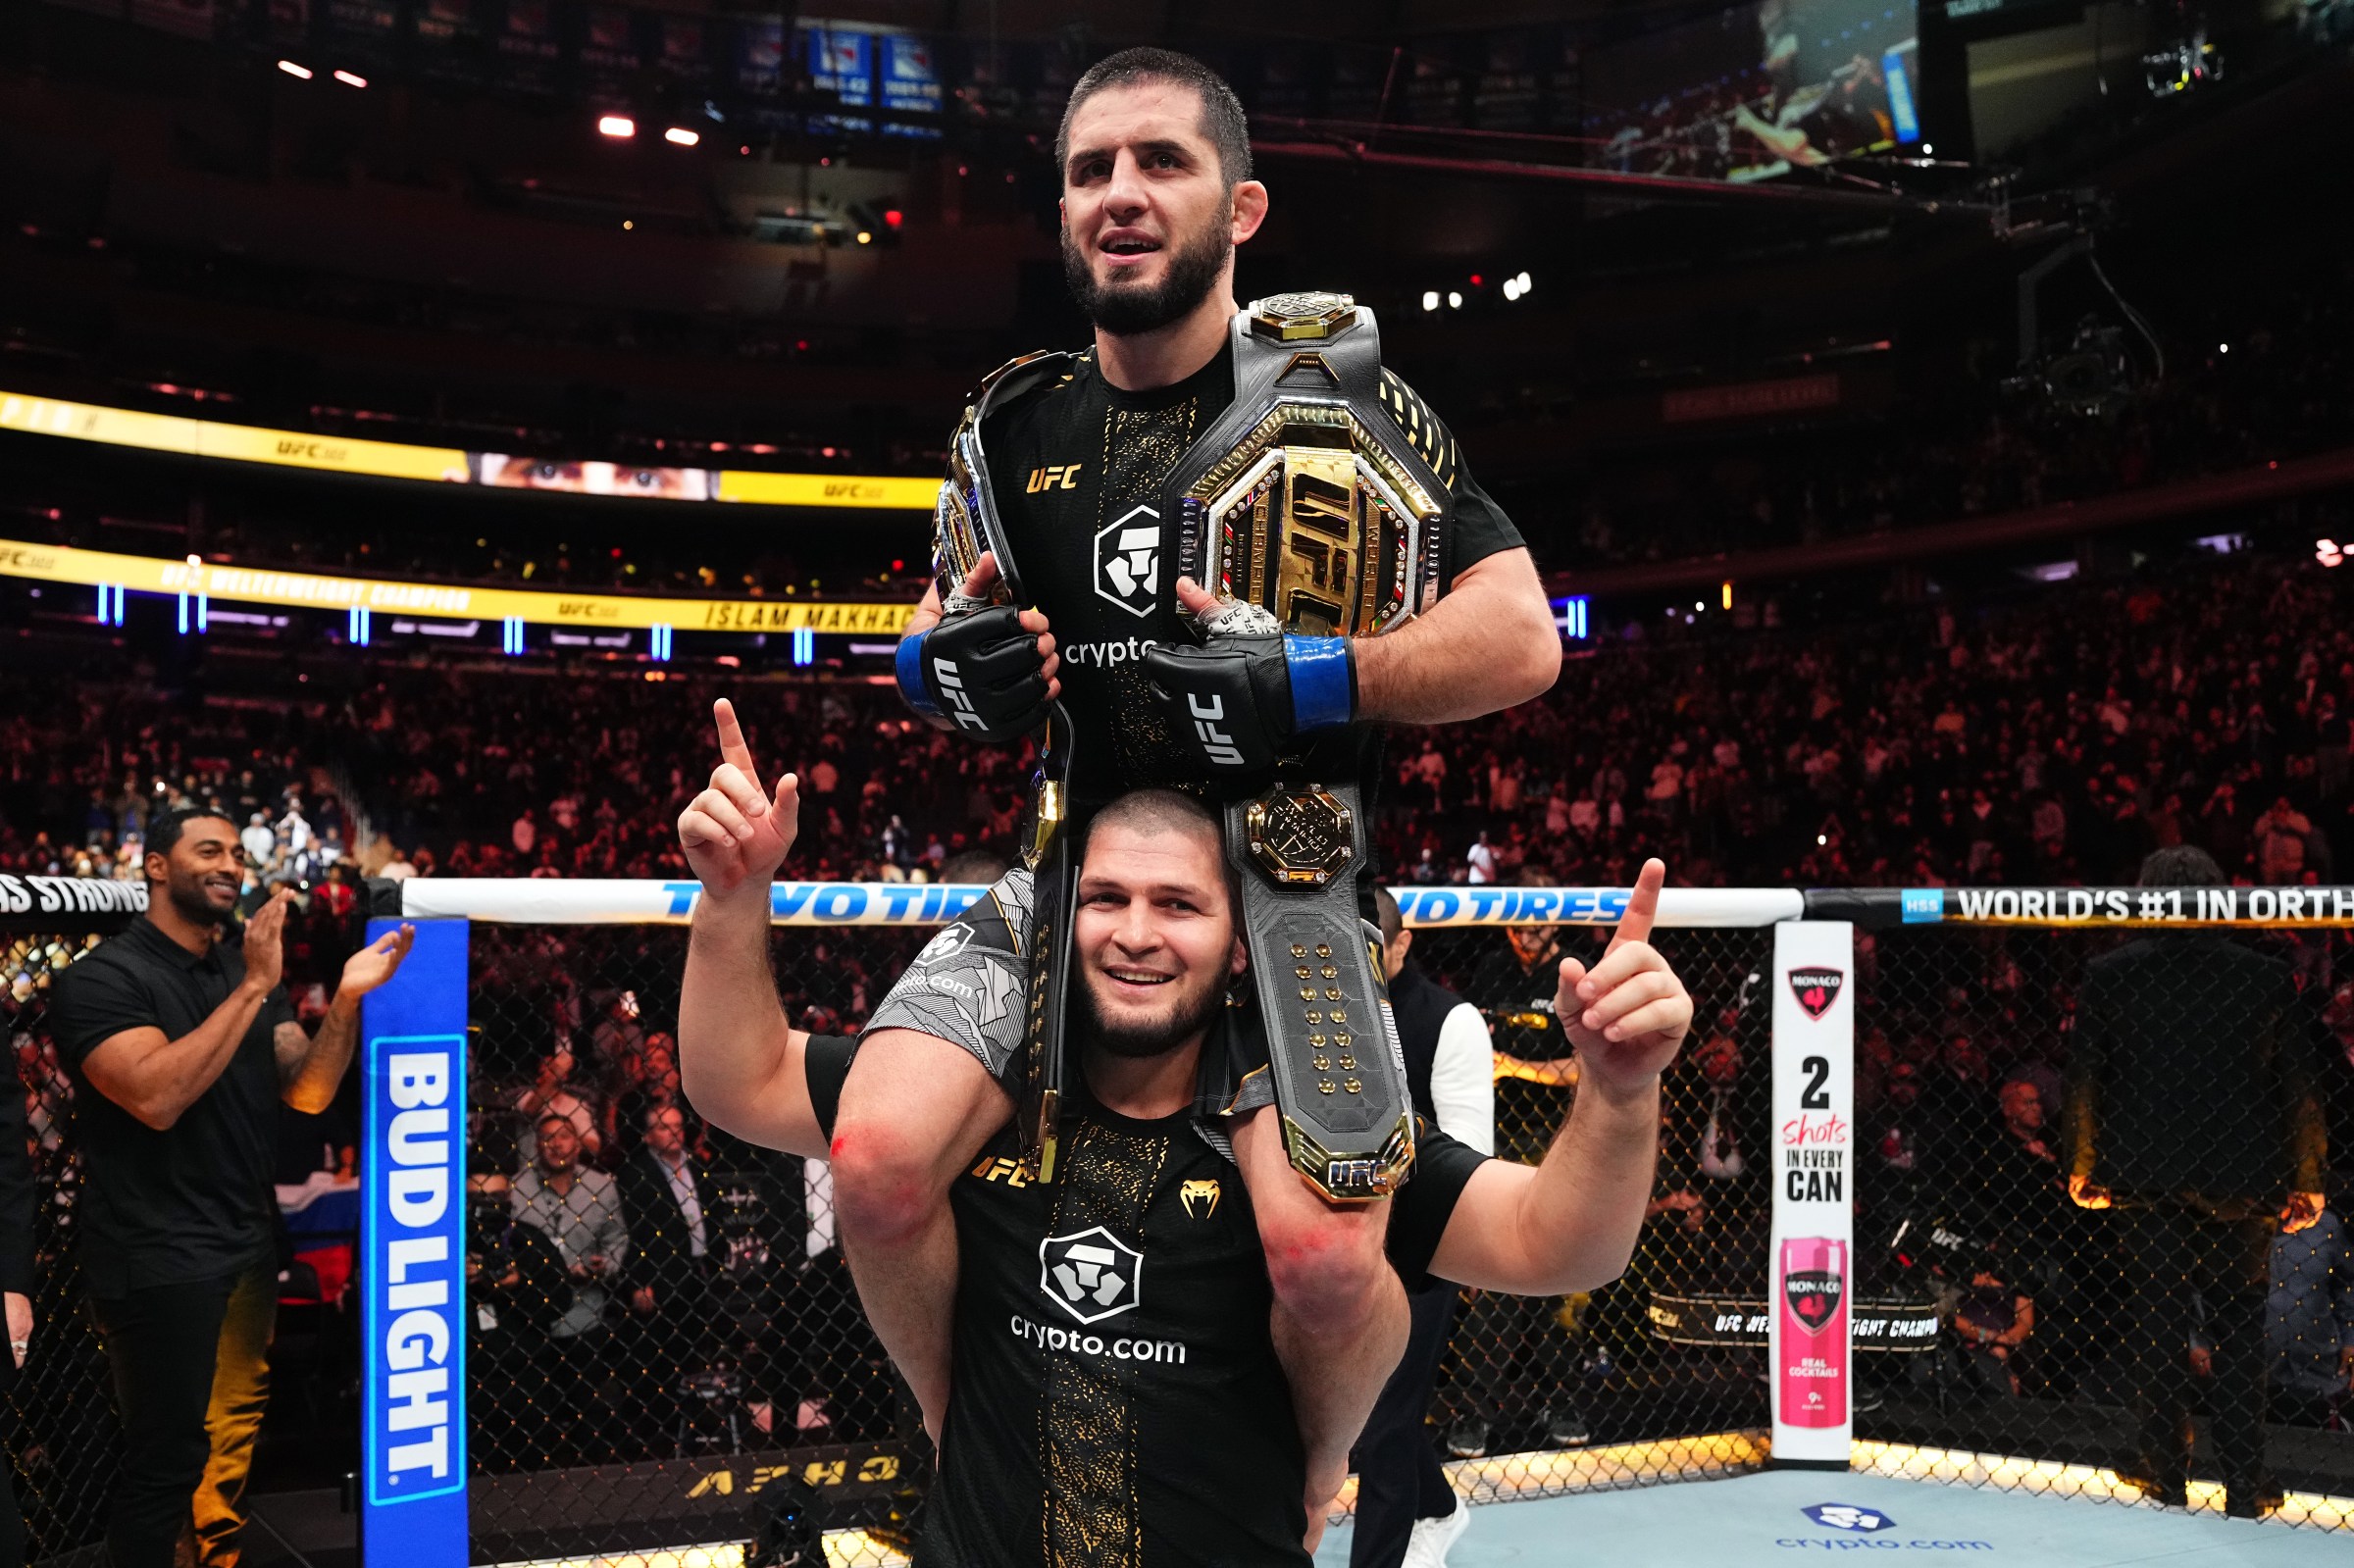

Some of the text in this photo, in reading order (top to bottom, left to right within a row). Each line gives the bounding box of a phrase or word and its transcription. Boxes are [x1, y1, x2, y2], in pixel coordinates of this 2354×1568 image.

[1026, 463, 1082, 493] UFC
[1249, 504, 1269, 606] CHAMPIO
[704, 606, 790, 629] ISLAM
[1220, 608, 1242, 626] UFC
[934, 657, 990, 732] UFC
[1187, 692, 1246, 765] UFC
[660, 884, 869, 922] TYO
[1469, 891, 1633, 923] TIRES
[1907, 899, 1939, 913] HSS
[1958, 889, 2129, 921] WORLD'S
[2138, 889, 2187, 922] #1
[2196, 889, 2237, 922] IN
[1792, 976, 1841, 987] MONACO
[1801, 1055, 1830, 1109] 2
[1782, 1114, 1847, 1146] shots
[1328, 1159, 1387, 1188] UFC
[1786, 1149, 1843, 1168] IN EVERY
[1787, 1170, 1842, 1202] CAN
[386, 1052, 450, 1479] BUD LIGHT
[1787, 1281, 1841, 1293] MONACO
[1714, 1314, 1743, 1332] UFC
[1010, 1314, 1186, 1365] crypto.com
[1788, 1366, 1839, 1378] COCKTAILS
[1802, 1357, 1827, 1368] REAL
[1775, 1538, 1995, 1551] crypto.com
